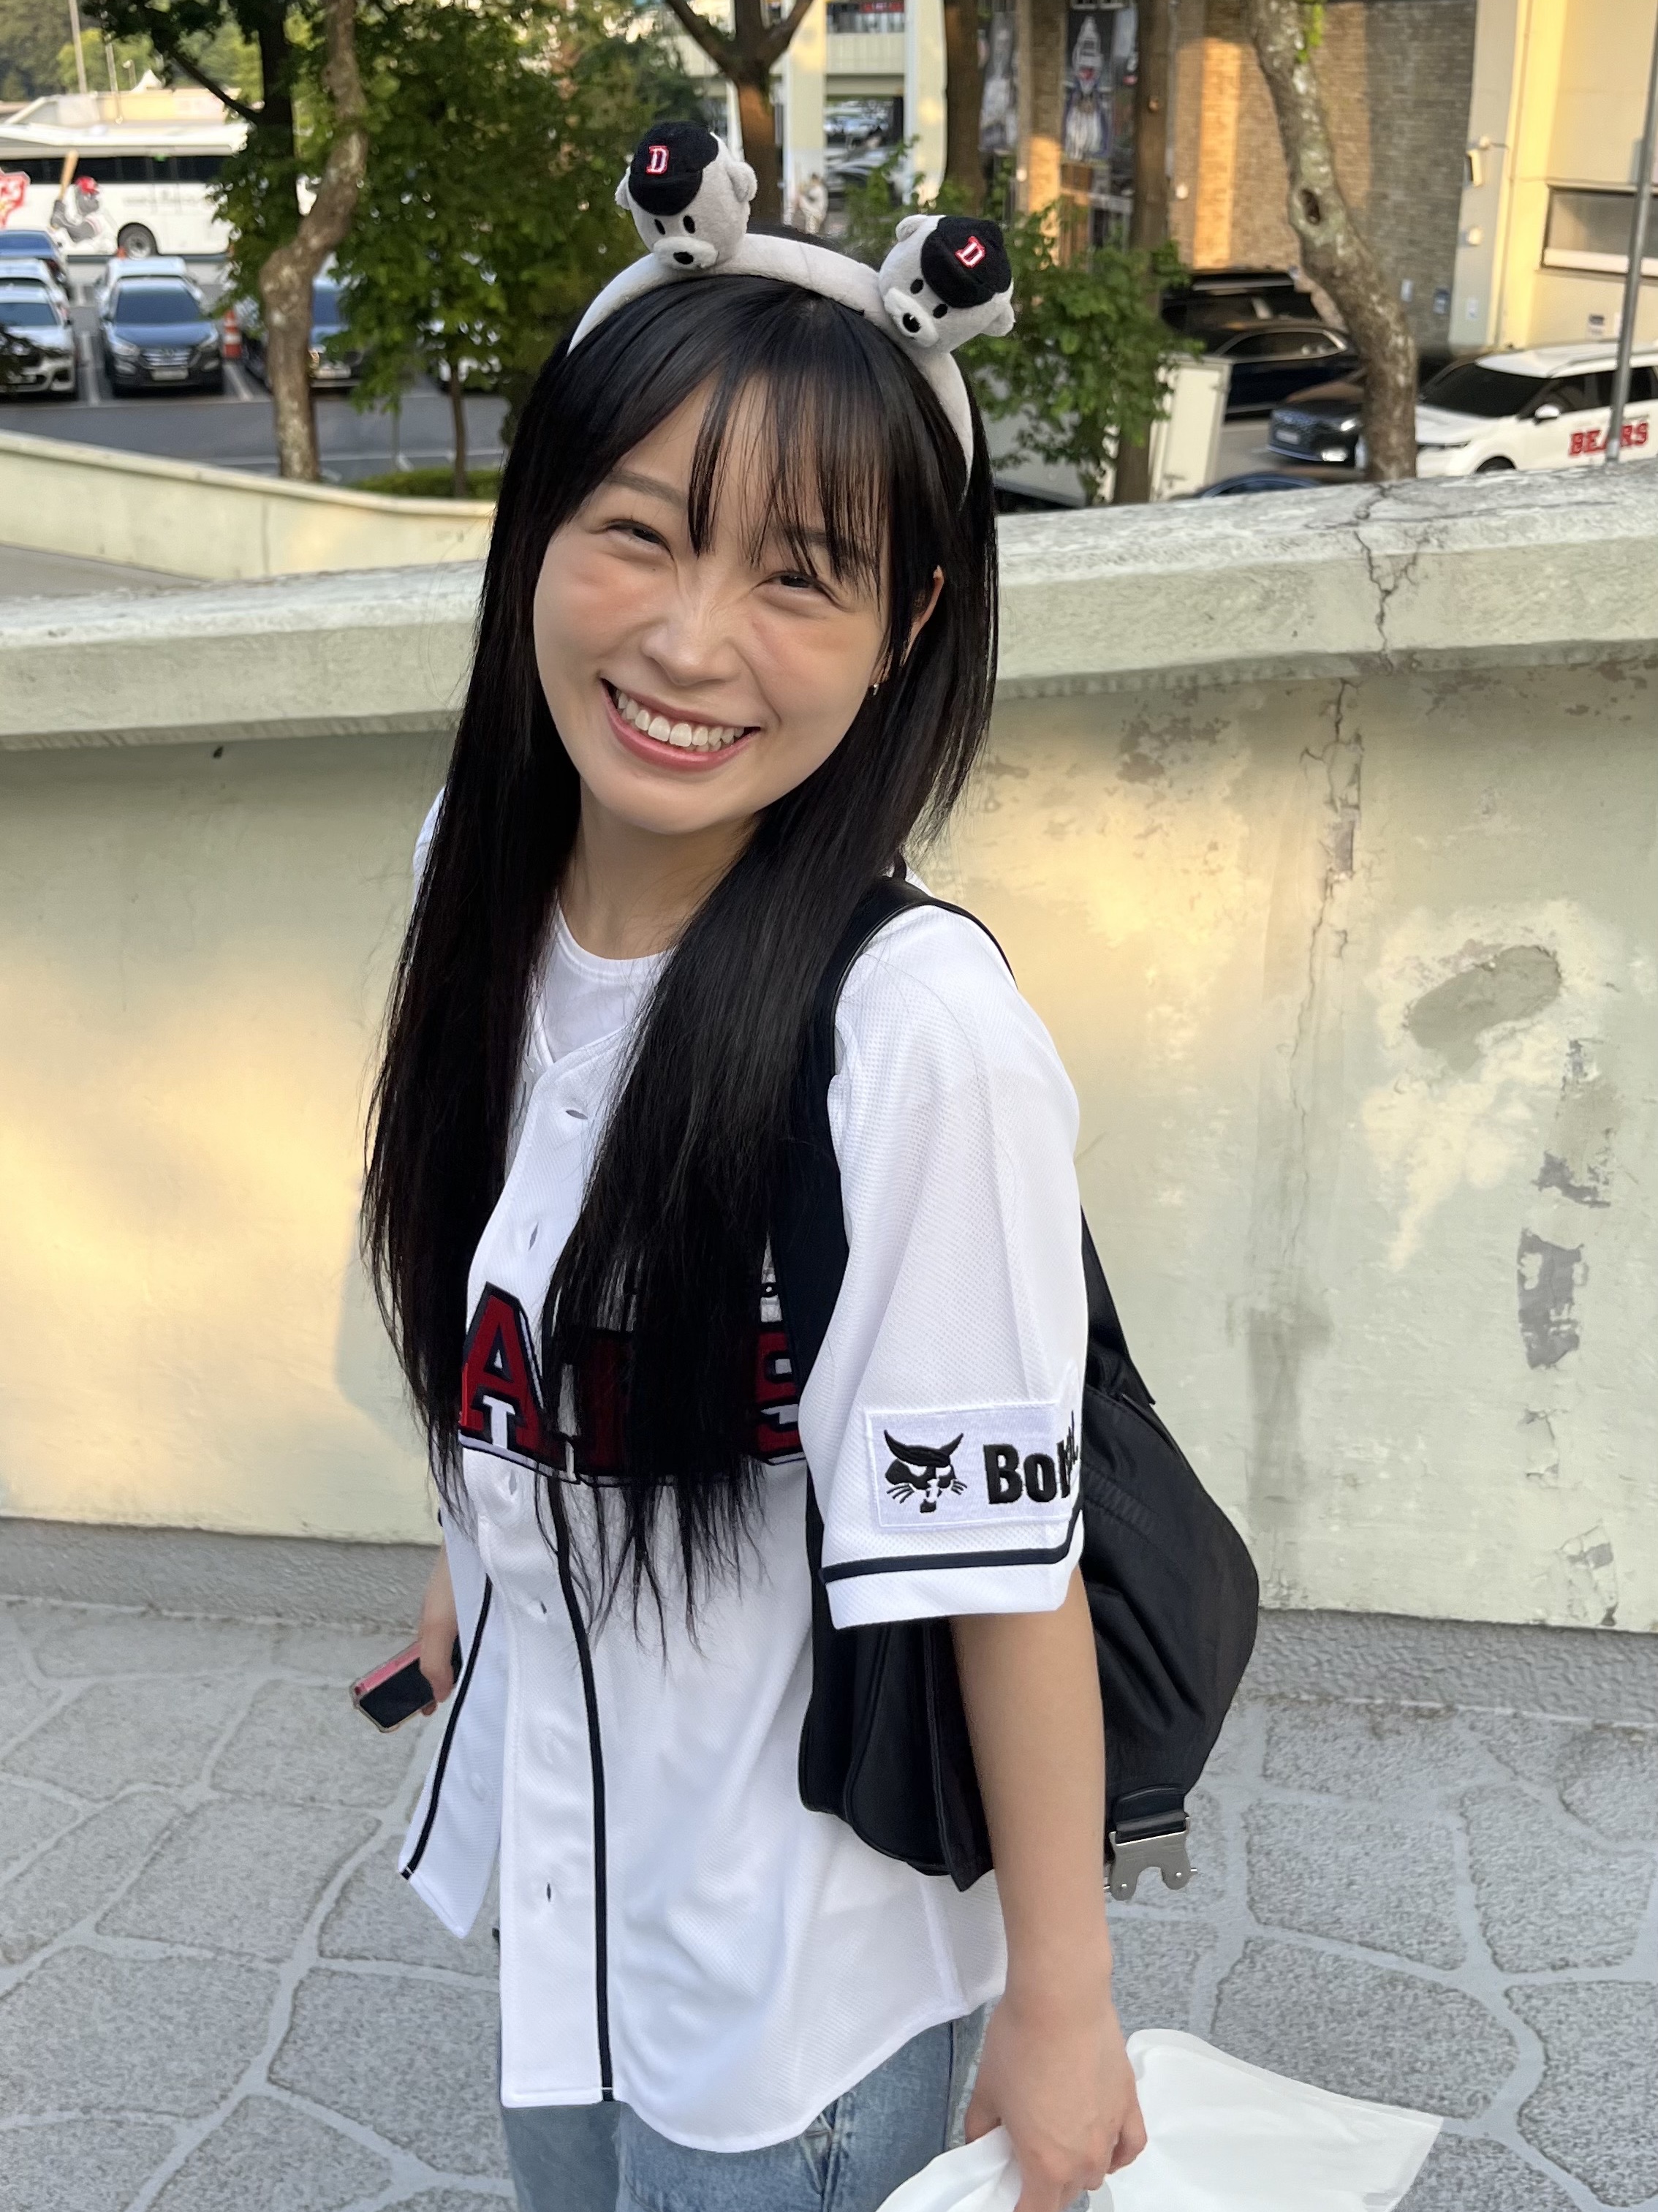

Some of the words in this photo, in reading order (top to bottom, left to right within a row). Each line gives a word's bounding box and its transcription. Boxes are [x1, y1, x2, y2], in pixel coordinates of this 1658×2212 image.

[646, 145, 669, 174] D
[955, 235, 985, 268] D
[1569, 423, 1649, 456] BERS
